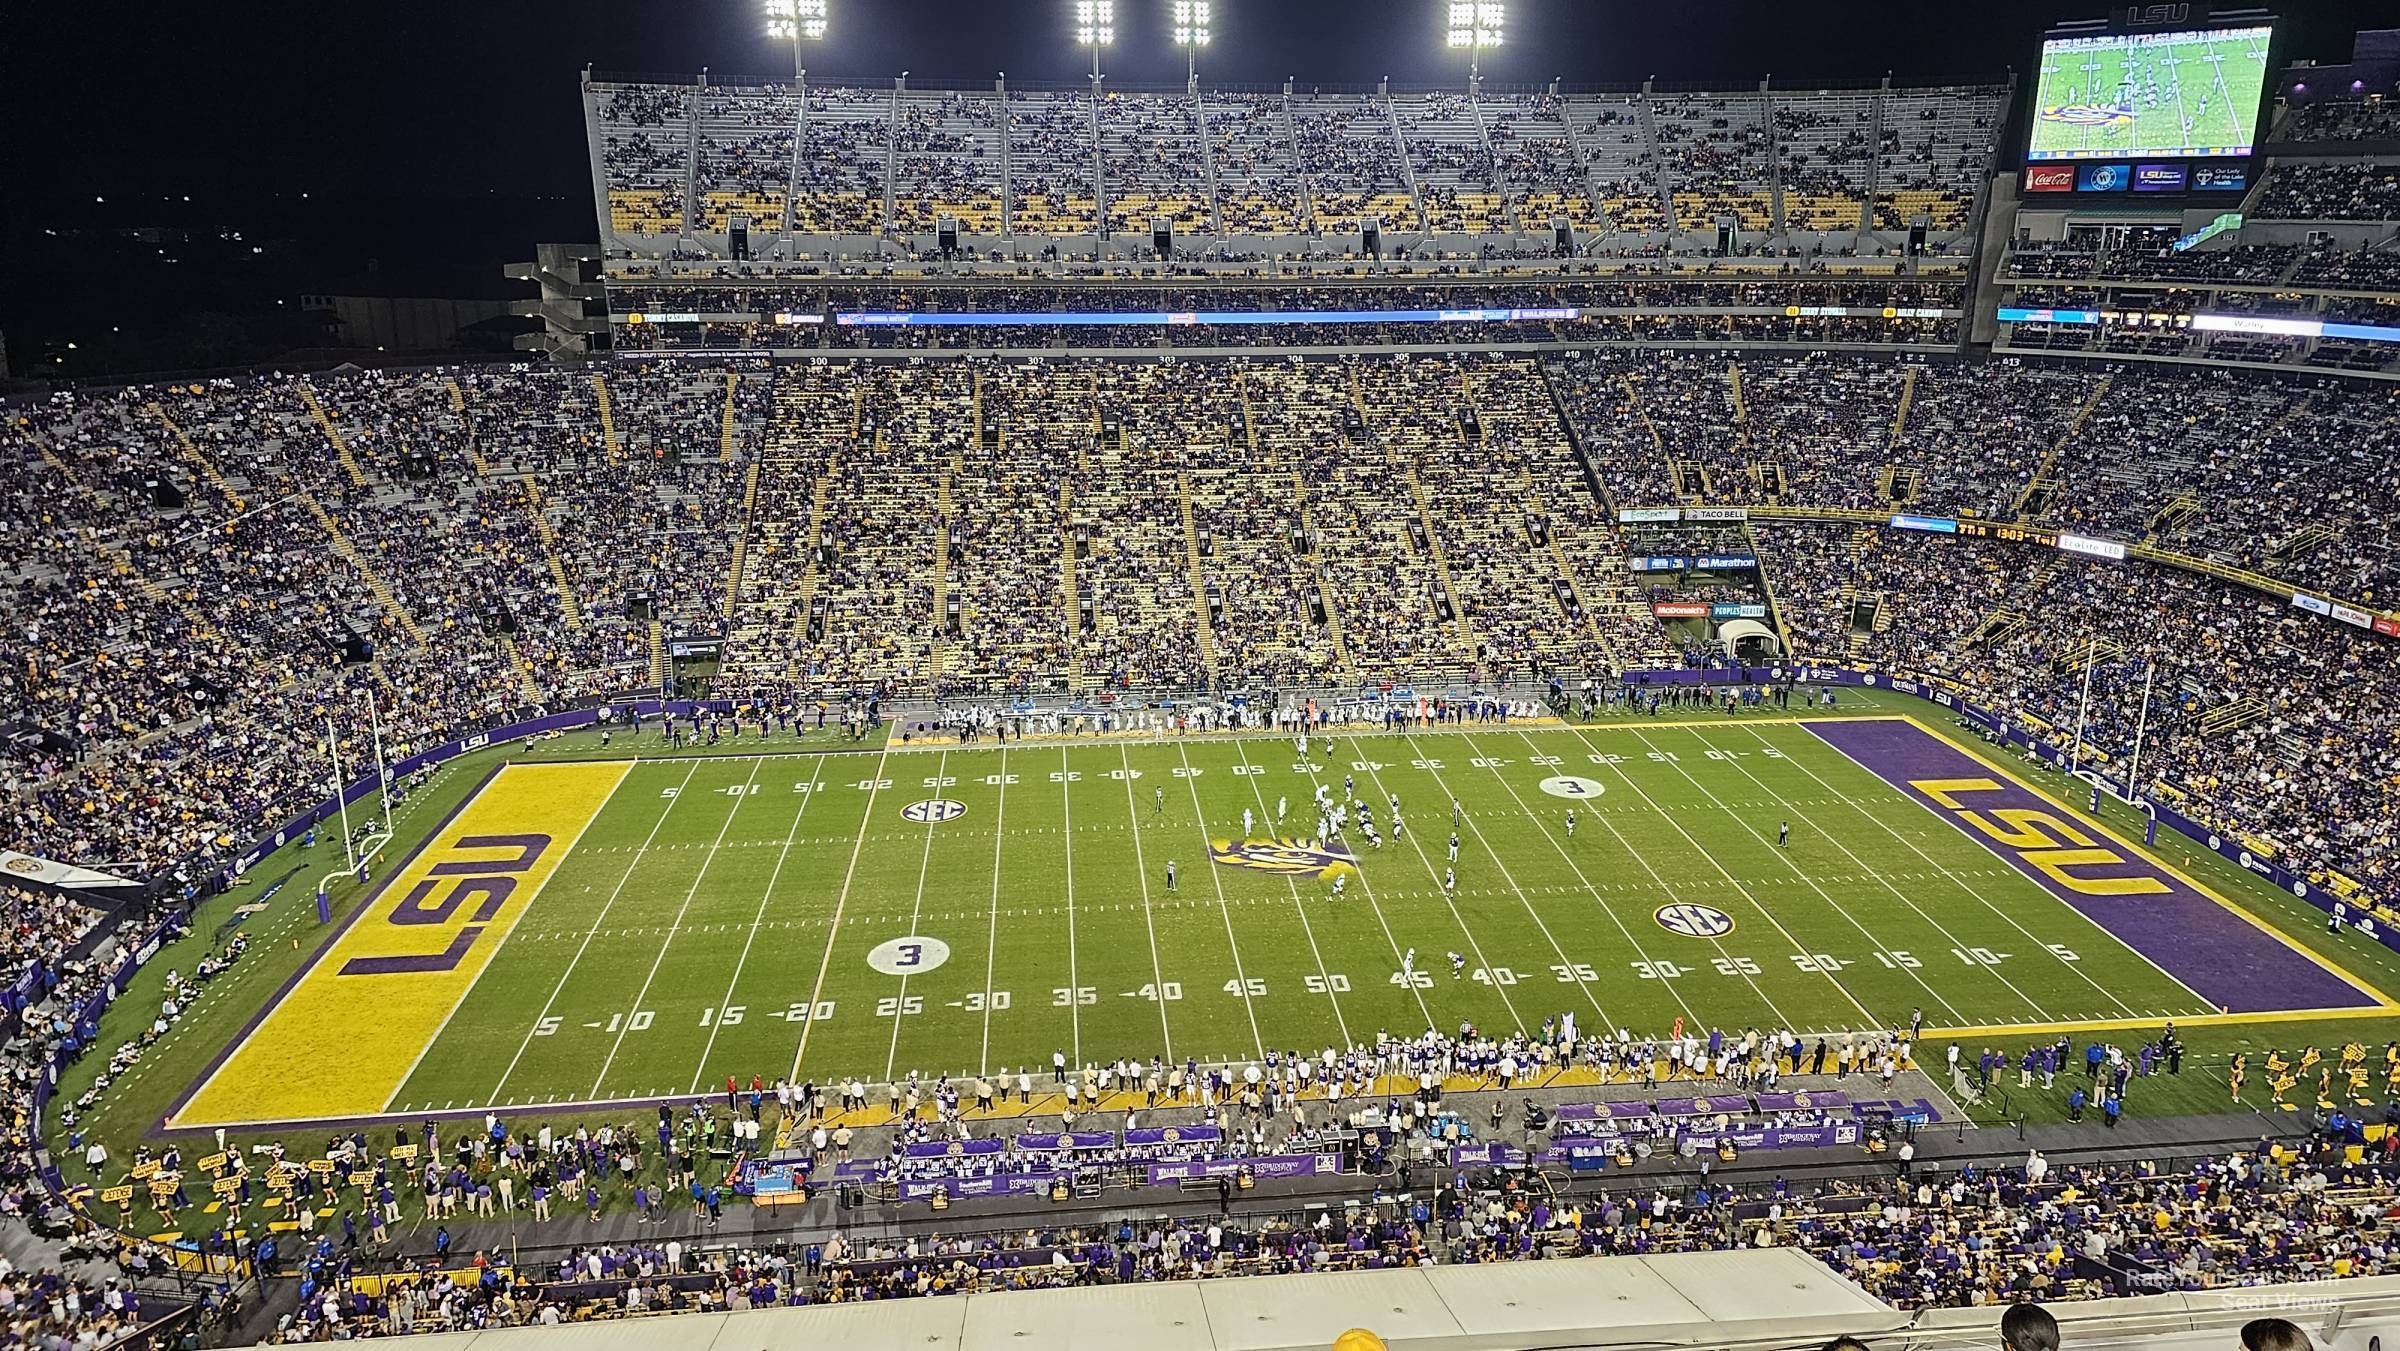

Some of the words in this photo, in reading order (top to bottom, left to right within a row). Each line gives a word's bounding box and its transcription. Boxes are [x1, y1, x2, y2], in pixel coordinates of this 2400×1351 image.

[2127, 3, 2189, 25] LSU
[2140, 171, 2163, 179] LSU
[810, 357, 828, 366] 300
[908, 356, 924, 365] 301
[1028, 356, 1044, 365] 302
[1159, 356, 1176, 364] 303
[1394, 353, 1410, 362] 305
[509, 363, 529, 373] 242
[1725, 510, 1744, 518] BELL
[1710, 558, 1755, 567] Marathon
[1656, 606, 1706, 615] McDonald's
[1715, 605, 1740, 615] PEOPLES
[1741, 605, 1763, 615] HEALTH
[460, 732, 489, 752] LSU
[1646, 752, 1680, 762] 15
[1703, 750, 1740, 760] 10
[1761, 748, 1783, 758] 5
[1410, 759, 1446, 769] 35
[1470, 757, 1505, 768] 30
[1528, 756, 1564, 765] 25
[1587, 754, 1626, 764] 20
[1231, 765, 1266, 775] 50
[1292, 763, 1324, 773] 45
[1351, 761, 1383, 771] 40
[1049, 771, 1082, 782] 35
[1111, 769, 1143, 780] 40
[1172, 767, 1204, 778] 45
[857, 778, 893, 790] 20
[922, 777, 956, 787] 25
[986, 774, 1020, 785] 30
[660, 788, 679, 798] 5
[726, 783, 760, 796] 10
[793, 782, 825, 793] 15
[906, 802, 963, 821] SEC
[1906, 778, 2175, 896] LSU
[336, 833, 552, 976] LSU
[1659, 905, 1729, 936] SEC
[895, 944, 922, 966] 3
[1951, 947, 2002, 965] 10
[2046, 943, 2081, 961] 5
[1789, 954, 1843, 972] 20
[1872, 951, 1923, 968] 15
[1630, 960, 1682, 979] 30
[1711, 957, 1763, 975] 25
[1471, 967, 1518, 986] 40
[1549, 963, 1600, 982] 35
[1304, 974, 1352, 994] 50
[1389, 970, 1435, 990] 45
[1137, 982, 1184, 1001] 40
[1223, 978, 1268, 997] 45
[1052, 986, 1097, 1006] 35
[875, 996, 924, 1017] 25
[964, 992, 1011, 1012] 30
[699, 1005, 748, 1027] 15
[785, 1001, 837, 1022] 20
[535, 1016, 564, 1036] 5
[606, 1011, 656, 1032] 10
